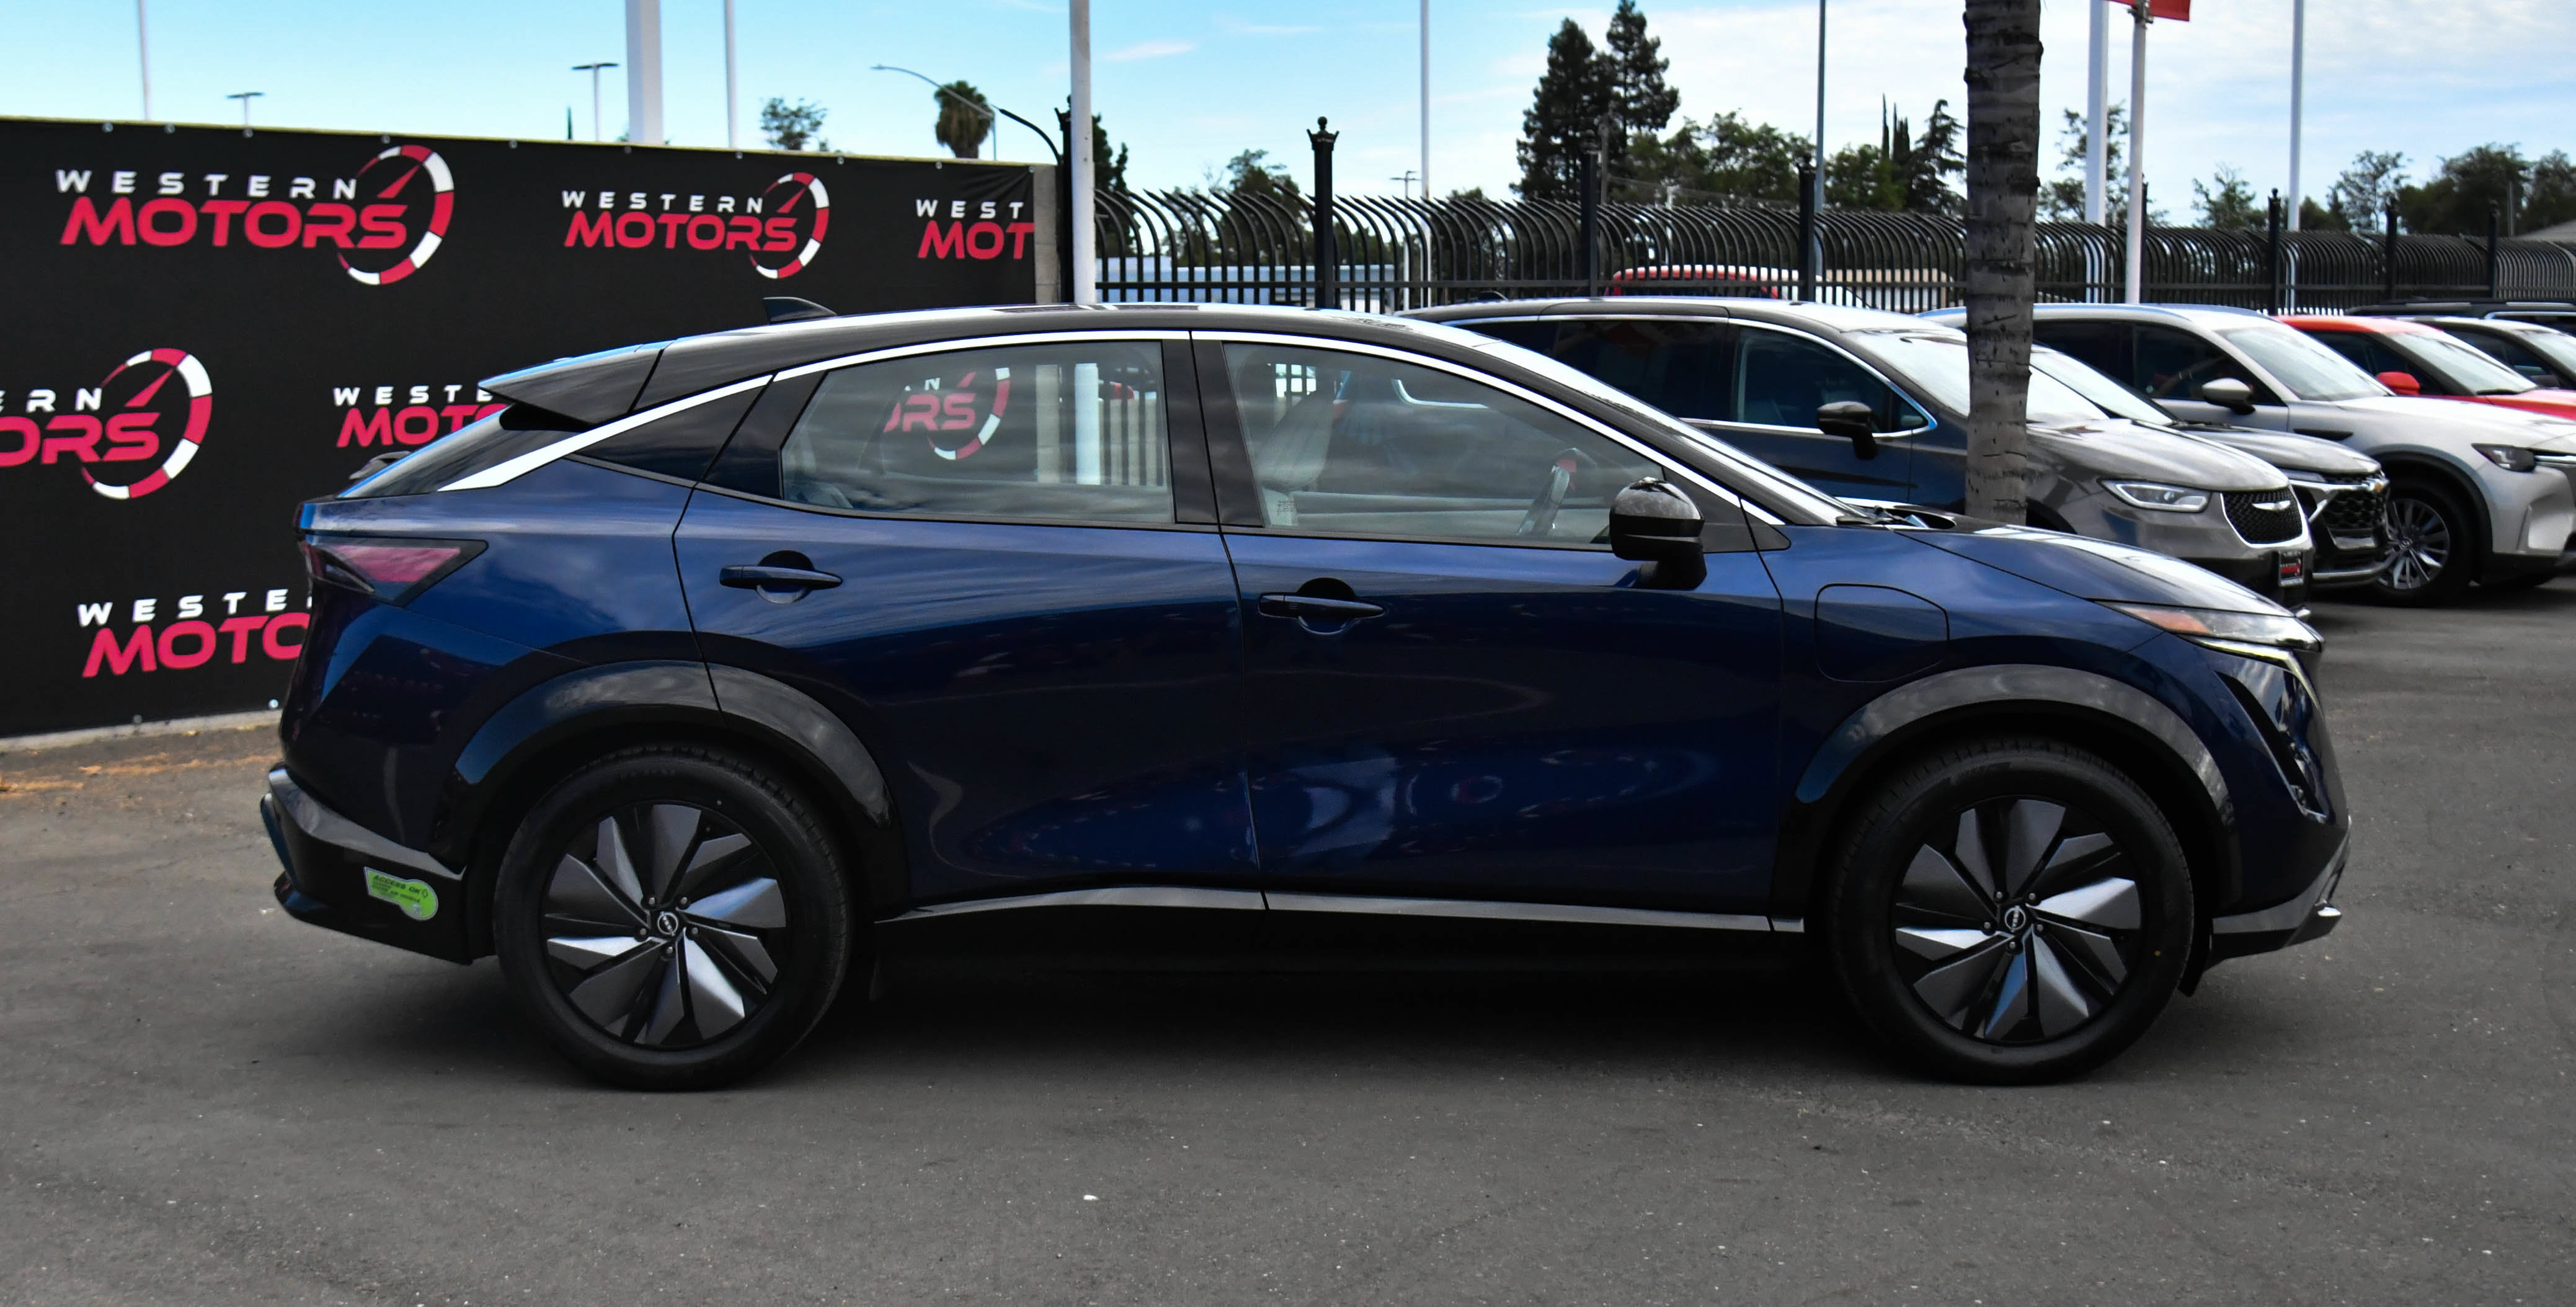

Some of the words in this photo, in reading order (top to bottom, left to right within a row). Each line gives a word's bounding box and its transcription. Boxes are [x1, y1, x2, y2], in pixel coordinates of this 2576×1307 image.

[56, 169, 357, 200] WESTERN
[562, 190, 763, 213] WESTERN
[60, 195, 408, 249] MOTORS
[915, 199, 1024, 219] WEST
[564, 210, 797, 252] MOTORS
[917, 220, 1035, 261] MOT
[336, 403, 508, 448] MOT
[883, 393, 976, 432] RS
[77, 588, 313, 627] WESTE
